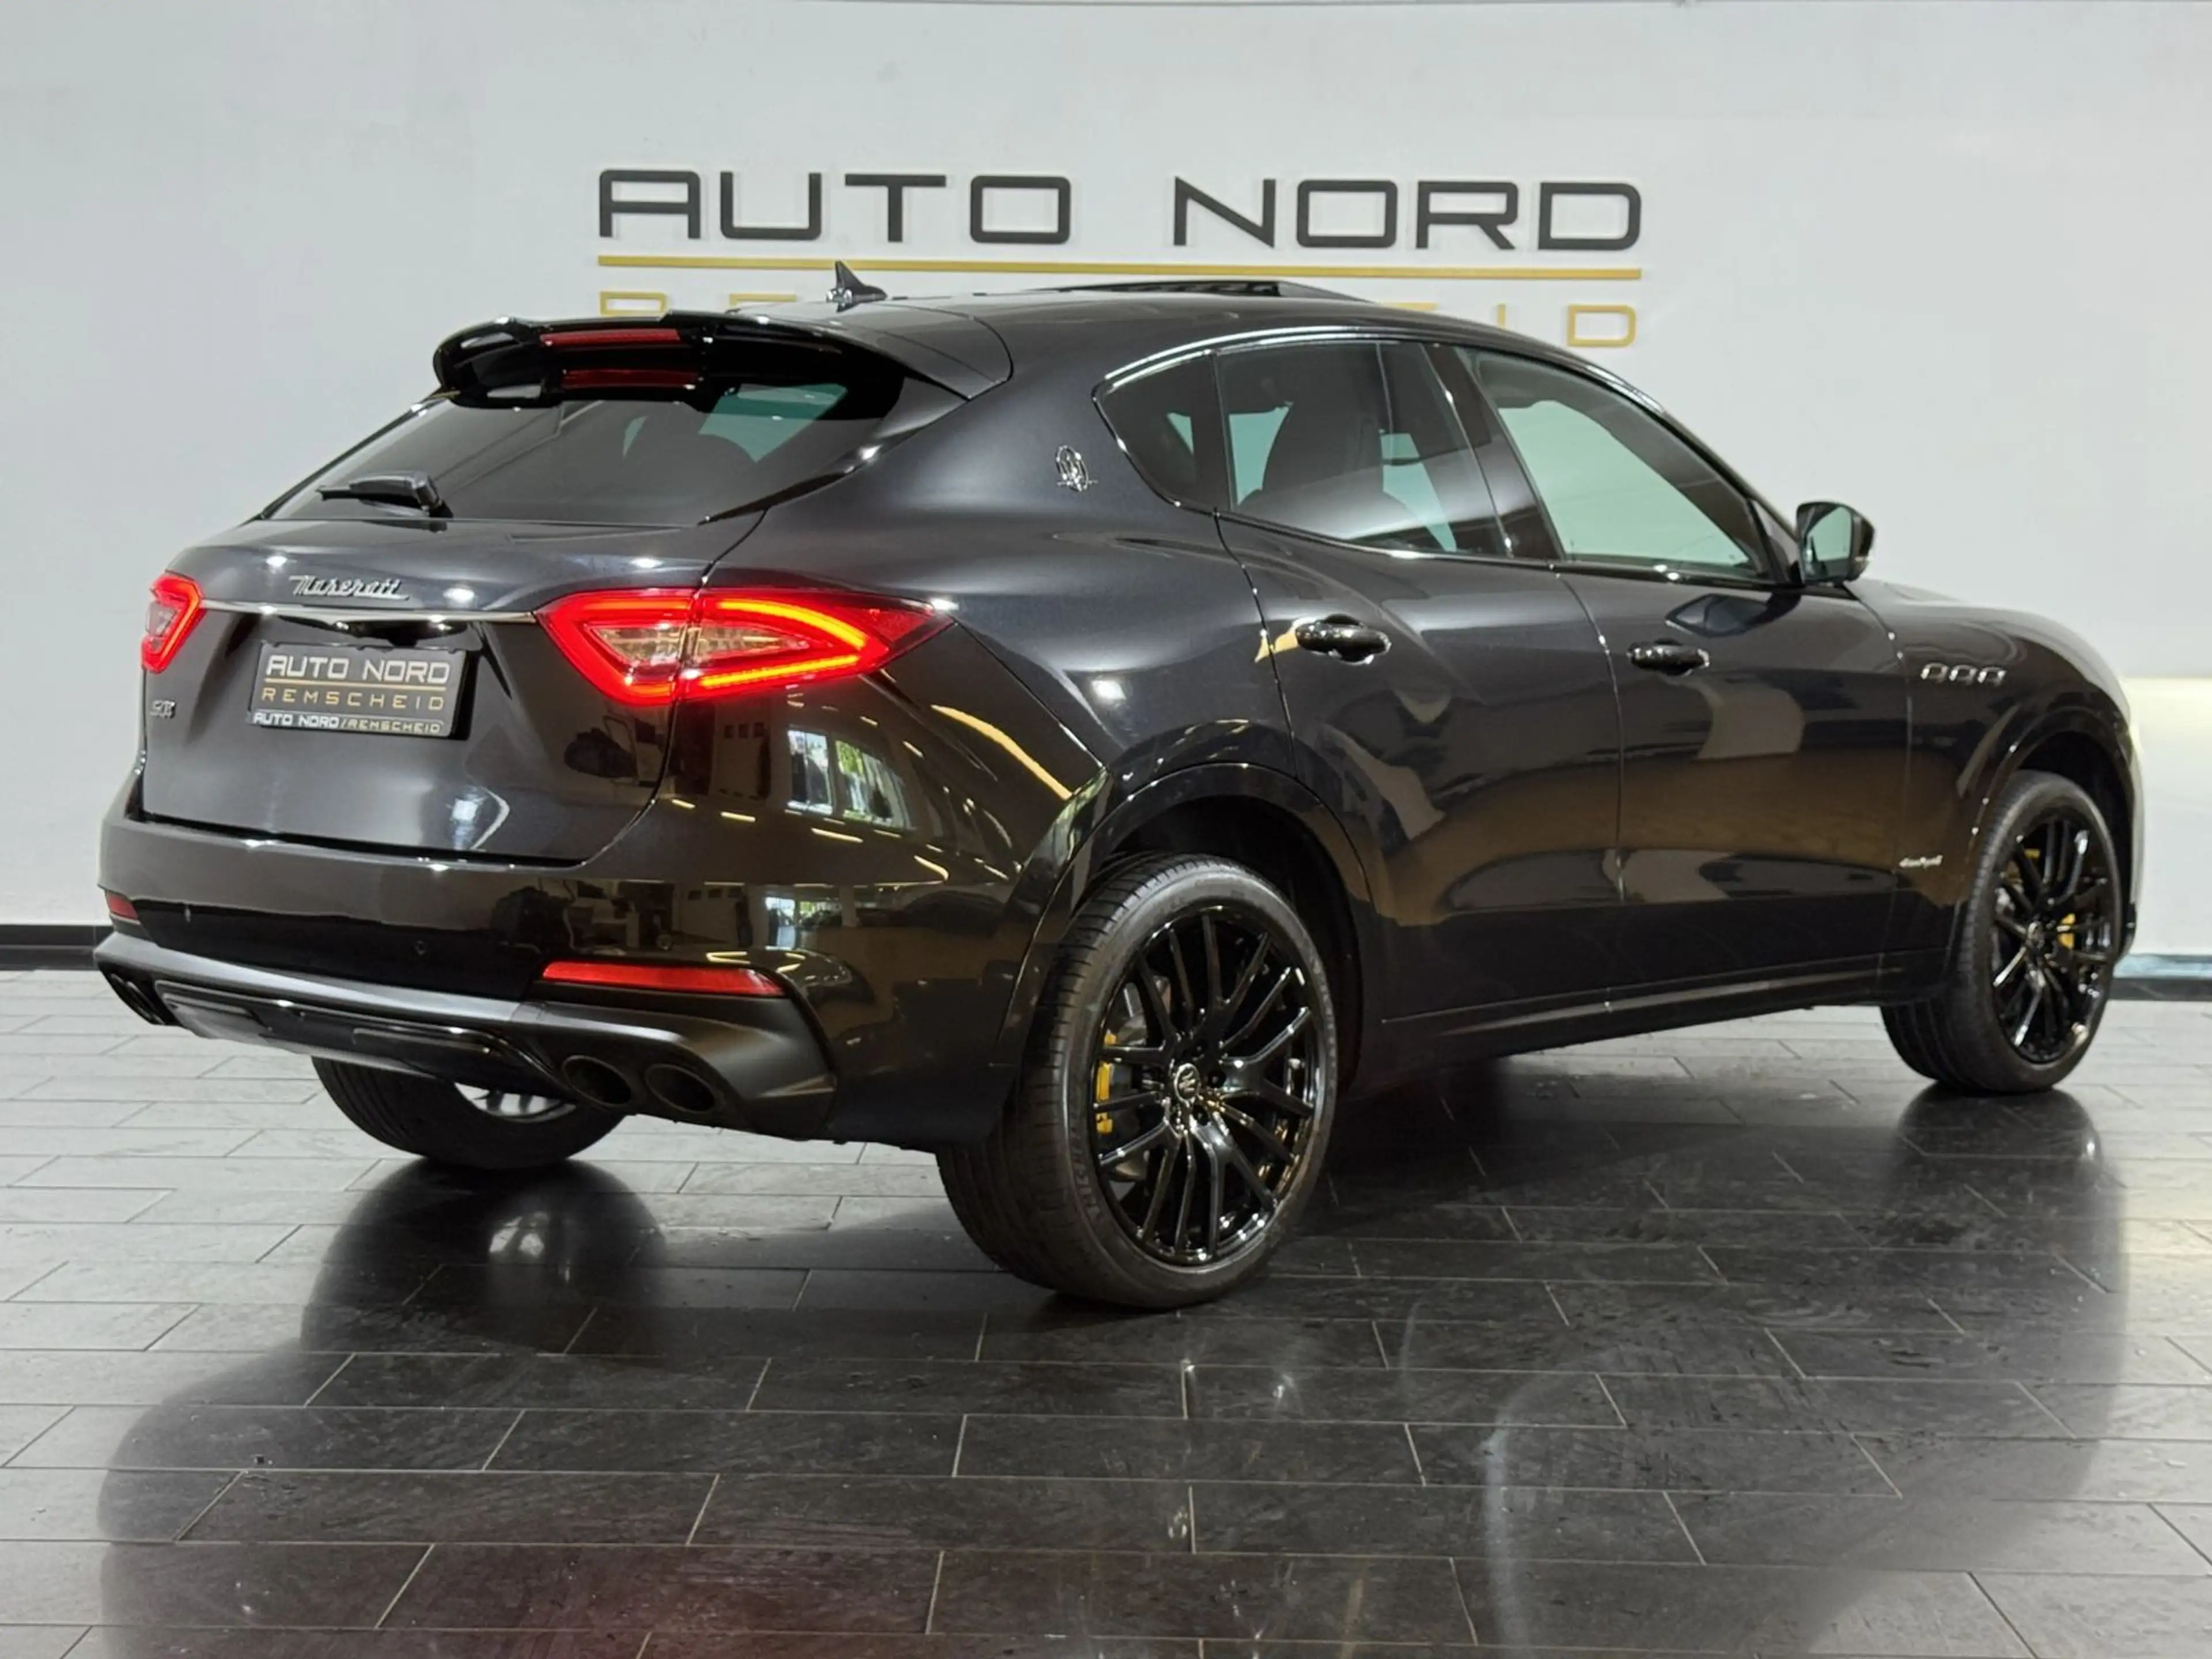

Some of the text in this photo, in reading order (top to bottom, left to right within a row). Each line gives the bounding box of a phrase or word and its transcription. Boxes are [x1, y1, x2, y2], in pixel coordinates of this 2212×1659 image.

[600, 169, 1642, 250] AUTO NORD
[289, 575, 410, 601] Maserati
[266, 654, 450, 684] AUTO NORD
[262, 687, 445, 711] REMSCHEID
[253, 712, 293, 726] AUTO
